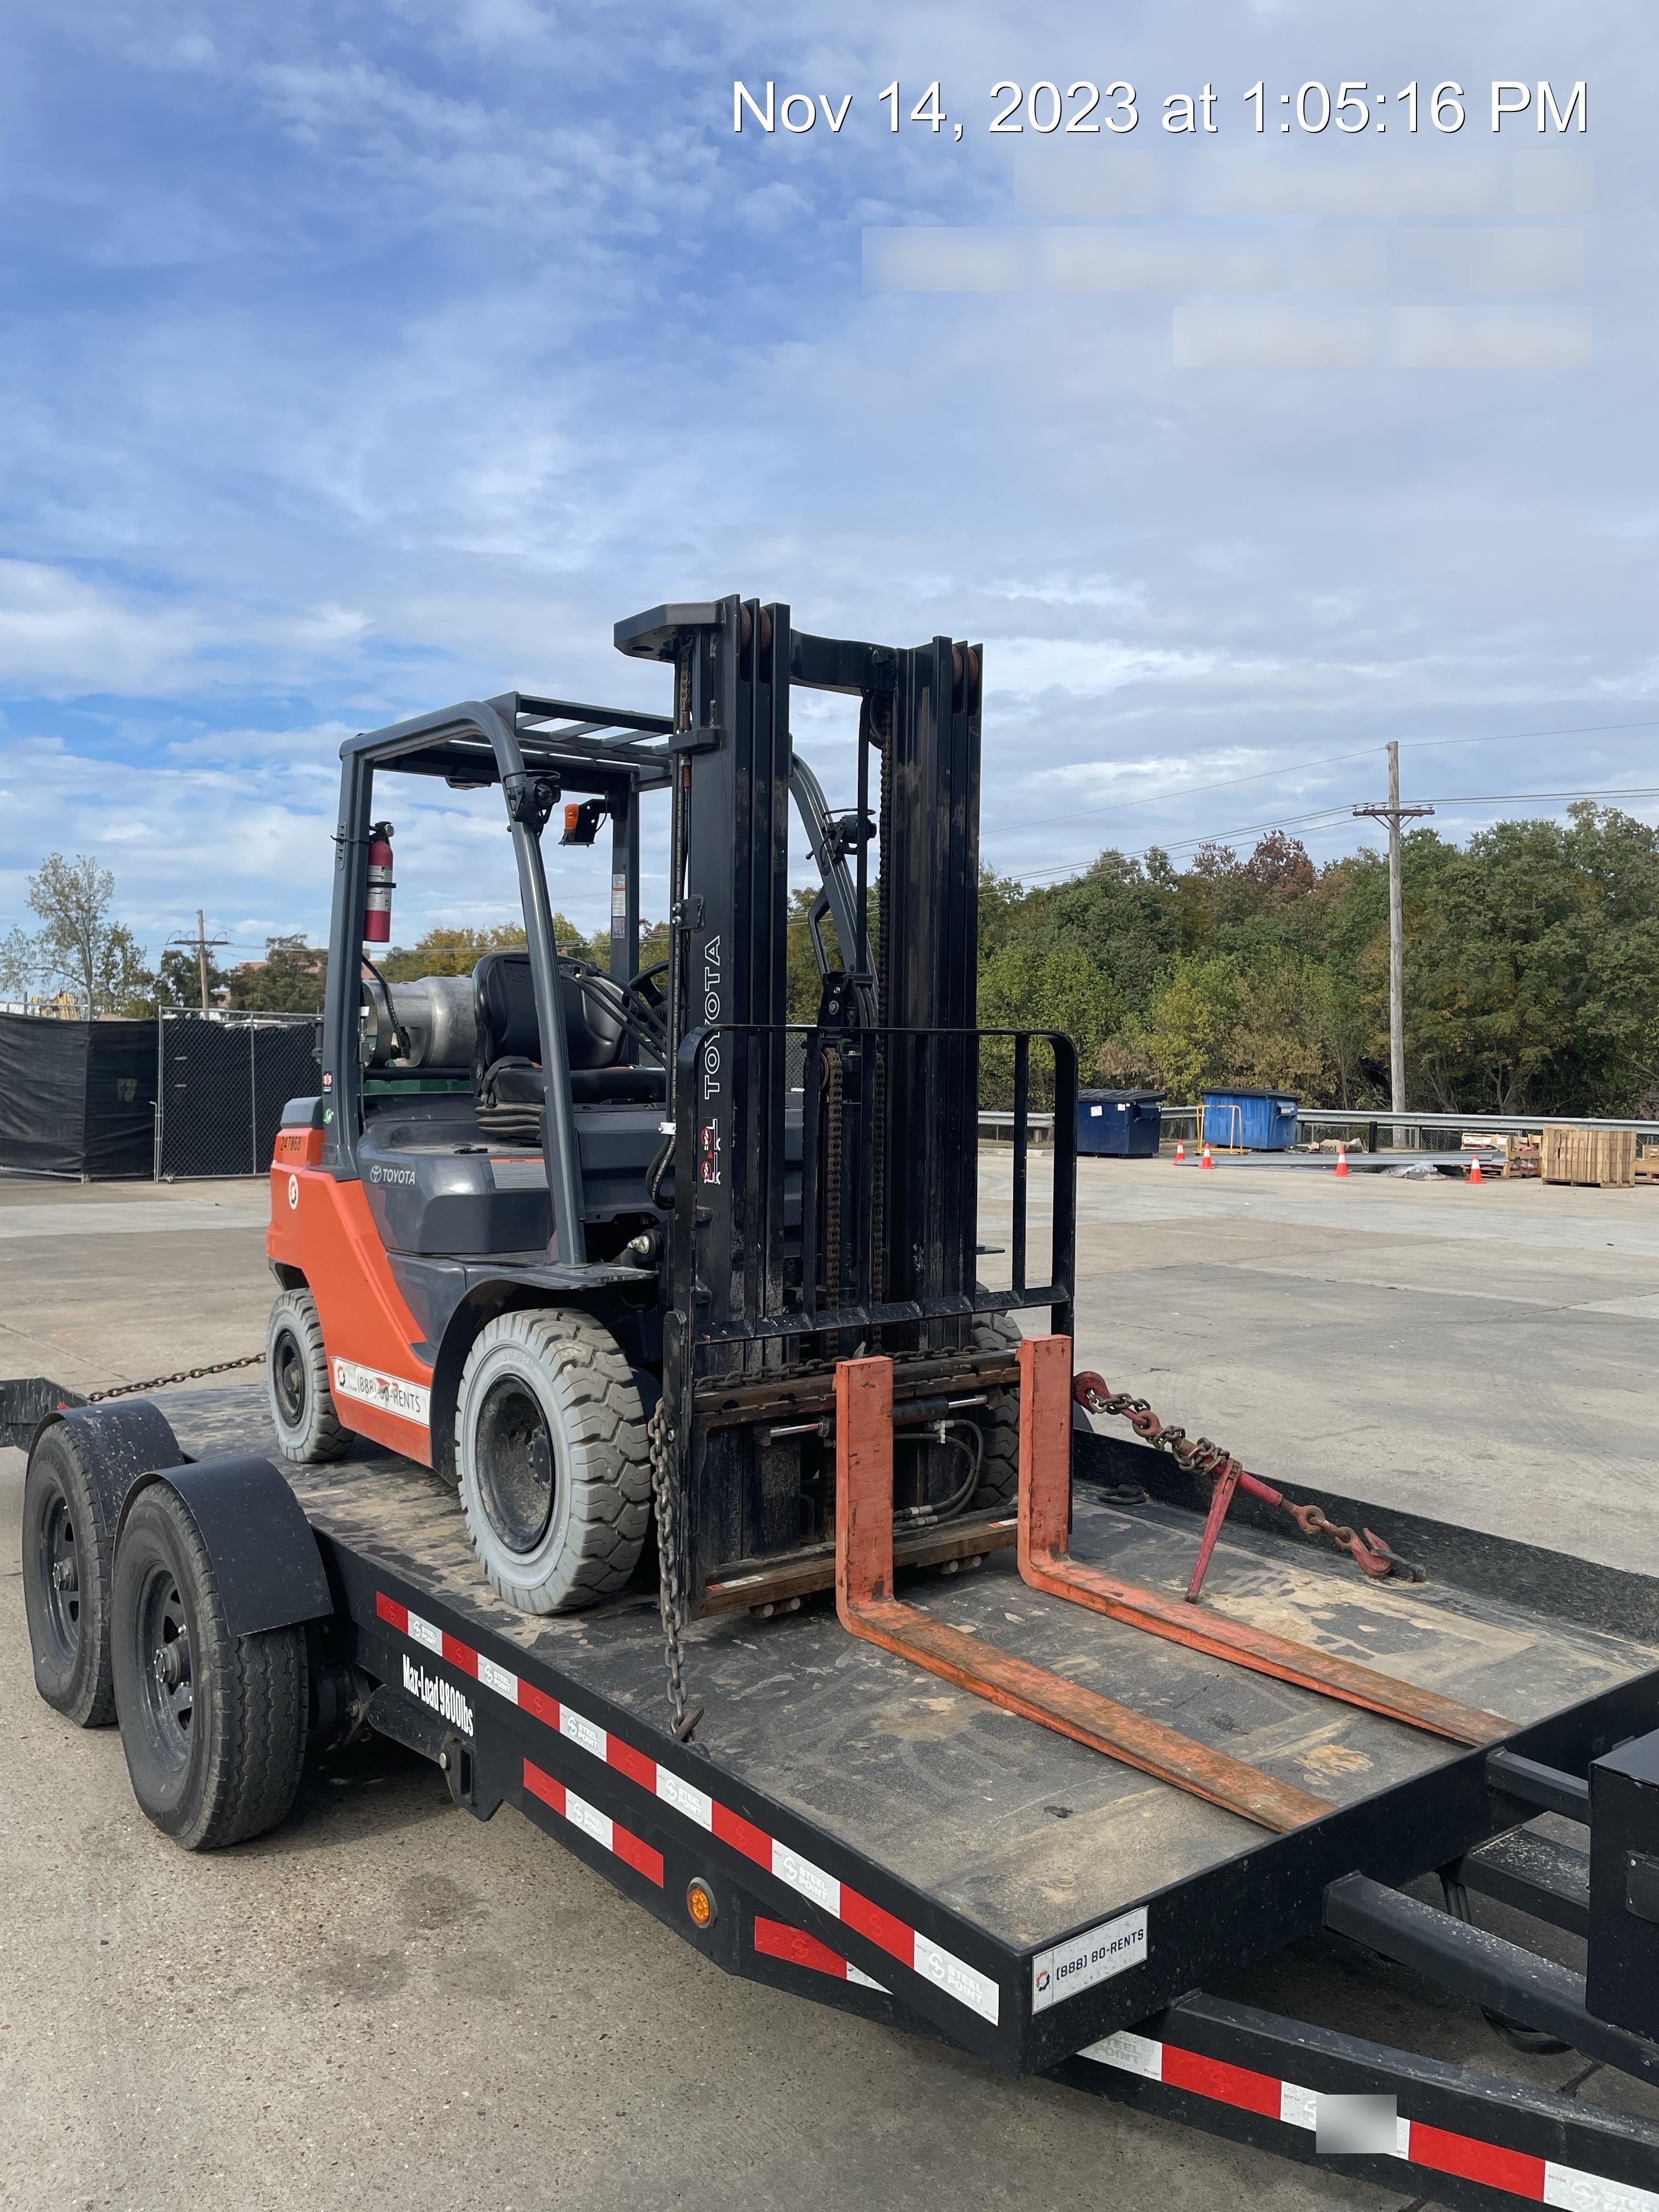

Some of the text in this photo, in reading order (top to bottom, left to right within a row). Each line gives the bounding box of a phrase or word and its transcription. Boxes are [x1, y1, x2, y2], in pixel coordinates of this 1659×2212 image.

[280, 1136, 301, 1151] 247068
[383, 1169, 415, 1185] TOYOTA
[380, 1386, 421, 1413] 0-RENTS
[421, 1626, 437, 1640] STEEL
[421, 1633, 437, 1646] POINT
[493, 1671, 510, 1686] STEEL
[493, 1678, 510, 1694] POINT
[403, 1654, 474, 1737] Max-Load 9800lbs
[578, 1723, 598, 1741] STEEL
[578, 1730, 598, 1748] POINT
[678, 1787, 702, 1809] STEEL
[678, 1795, 702, 1816] POINT
[799, 1866, 827, 1892] STEEL
[799, 1875, 827, 1900] POINT
[1056, 1928, 1144, 1980] (888) 80-RENTS
[947, 1964, 984, 1994] STEEL
[947, 1974, 983, 2004] POINT
